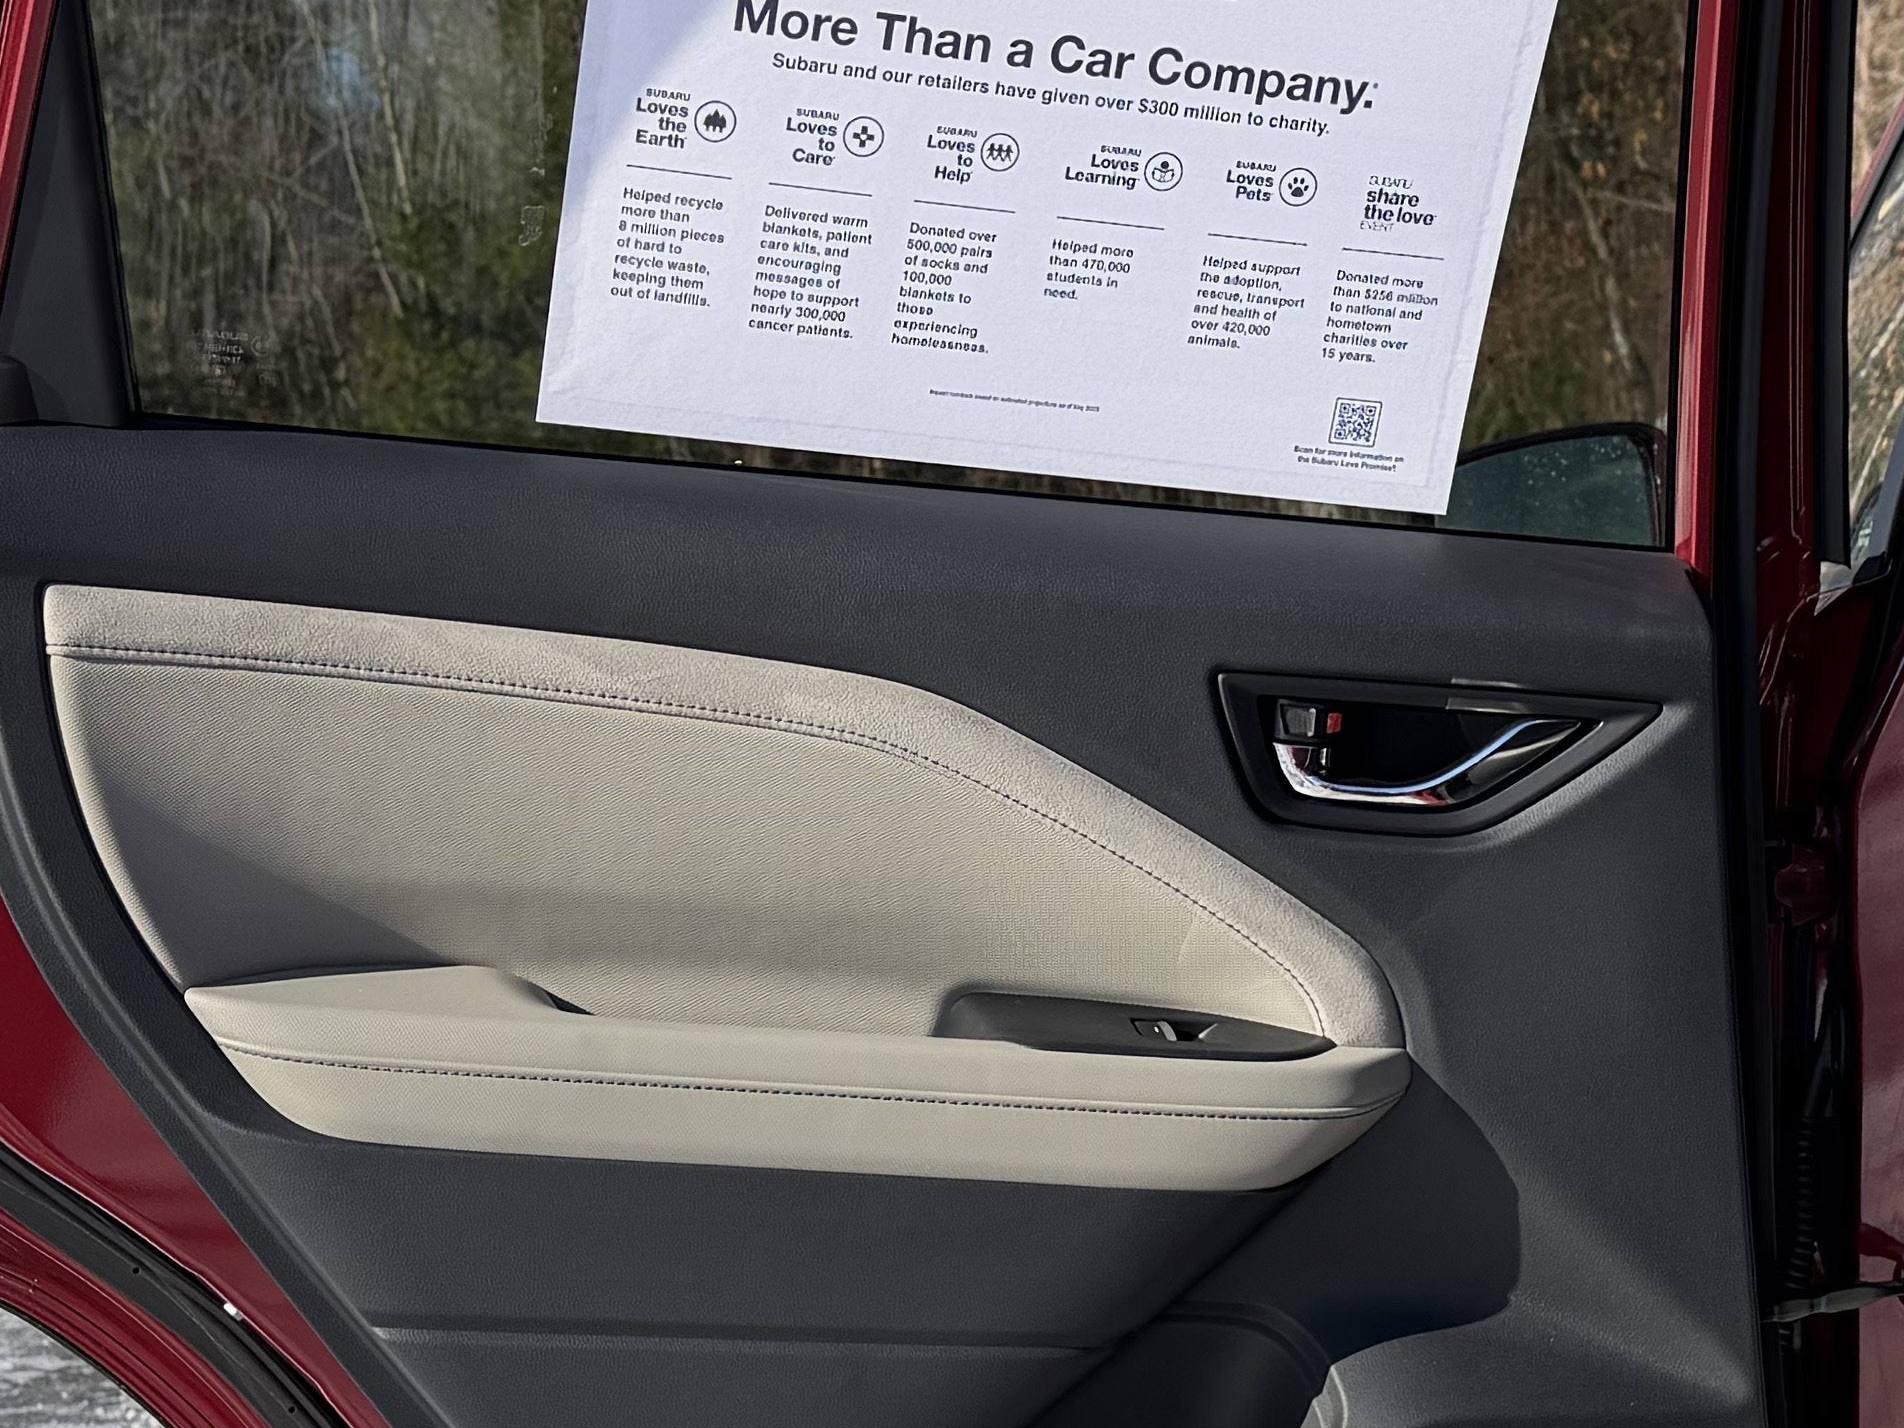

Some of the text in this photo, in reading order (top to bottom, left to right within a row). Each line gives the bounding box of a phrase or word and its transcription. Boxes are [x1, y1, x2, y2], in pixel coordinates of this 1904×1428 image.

[875, 11, 991, 63] Than
[1005, 38, 1033, 68] a
[1050, 34, 1135, 79] Car
[1142, 46, 1378, 115] Company.
[771, 51, 1329, 137] Subaru and our retailers have given over $300 million to charity.
[635, 96, 689, 118] Loves
[657, 116, 687, 133] the
[785, 116, 837, 137] Loves
[635, 128, 686, 149] Earth
[817, 136, 835, 152] to
[926, 133, 975, 153] Loves
[791, 147, 833, 166] Care
[956, 153, 973, 167] to
[1090, 153, 1139, 172] Loves
[933, 164, 971, 184] Help
[1064, 165, 1137, 190] Learning
[1225, 168, 1274, 187] Loves
[622, 186, 723, 210] Helped recycle
[1234, 184, 1271, 202] Pets
[1365, 187, 1419, 207] share
[620, 205, 690, 223] more than
[764, 204, 868, 228] Delivered warm
[1363, 203, 1434, 226] the love
[618, 219, 724, 243] 8 million pieces
[761, 220, 872, 245] blankets, patient
[909, 221, 997, 242] Donated over
[616, 236, 682, 254] of hard to
[759, 239, 849, 258] care kits, and
[906, 237, 992, 258] 500,000 pairs
[1051, 237, 1133, 258] Helped more
[614, 254, 709, 276] recycle waste,
[757, 255, 841, 276] encouraging
[903, 254, 988, 274] of socks and
[1049, 254, 1130, 273] than 470,000
[1202, 254, 1301, 276] Helped support
[612, 267, 703, 290] keeping them
[754, 271, 840, 289] messages of
[902, 269, 952, 286] 100,000
[1046, 271, 1118, 288] students in
[1199, 271, 1220, 283] the
[1336, 269, 1423, 289] Donated more
[610, 286, 710, 306] out of landfills.
[752, 284, 859, 307] hope to support
[898, 285, 971, 304] blankets to
[1043, 287, 1078, 300] need.
[1332, 285, 1360, 298] than
[1395, 292, 1438, 306] million
[750, 303, 846, 322] nearly 300,000
[896, 301, 933, 315] those
[1192, 303, 1277, 321] and health of
[1329, 300, 1423, 320] to national and
[748, 318, 853, 338] cancer patients.
[1190, 319, 1270, 336] over 420,000
[1325, 315, 1391, 333] hometown
[1187, 333, 1240, 349] animals.
[1322, 331, 1408, 350] charities over
[1321, 346, 1375, 363] 15 years.
